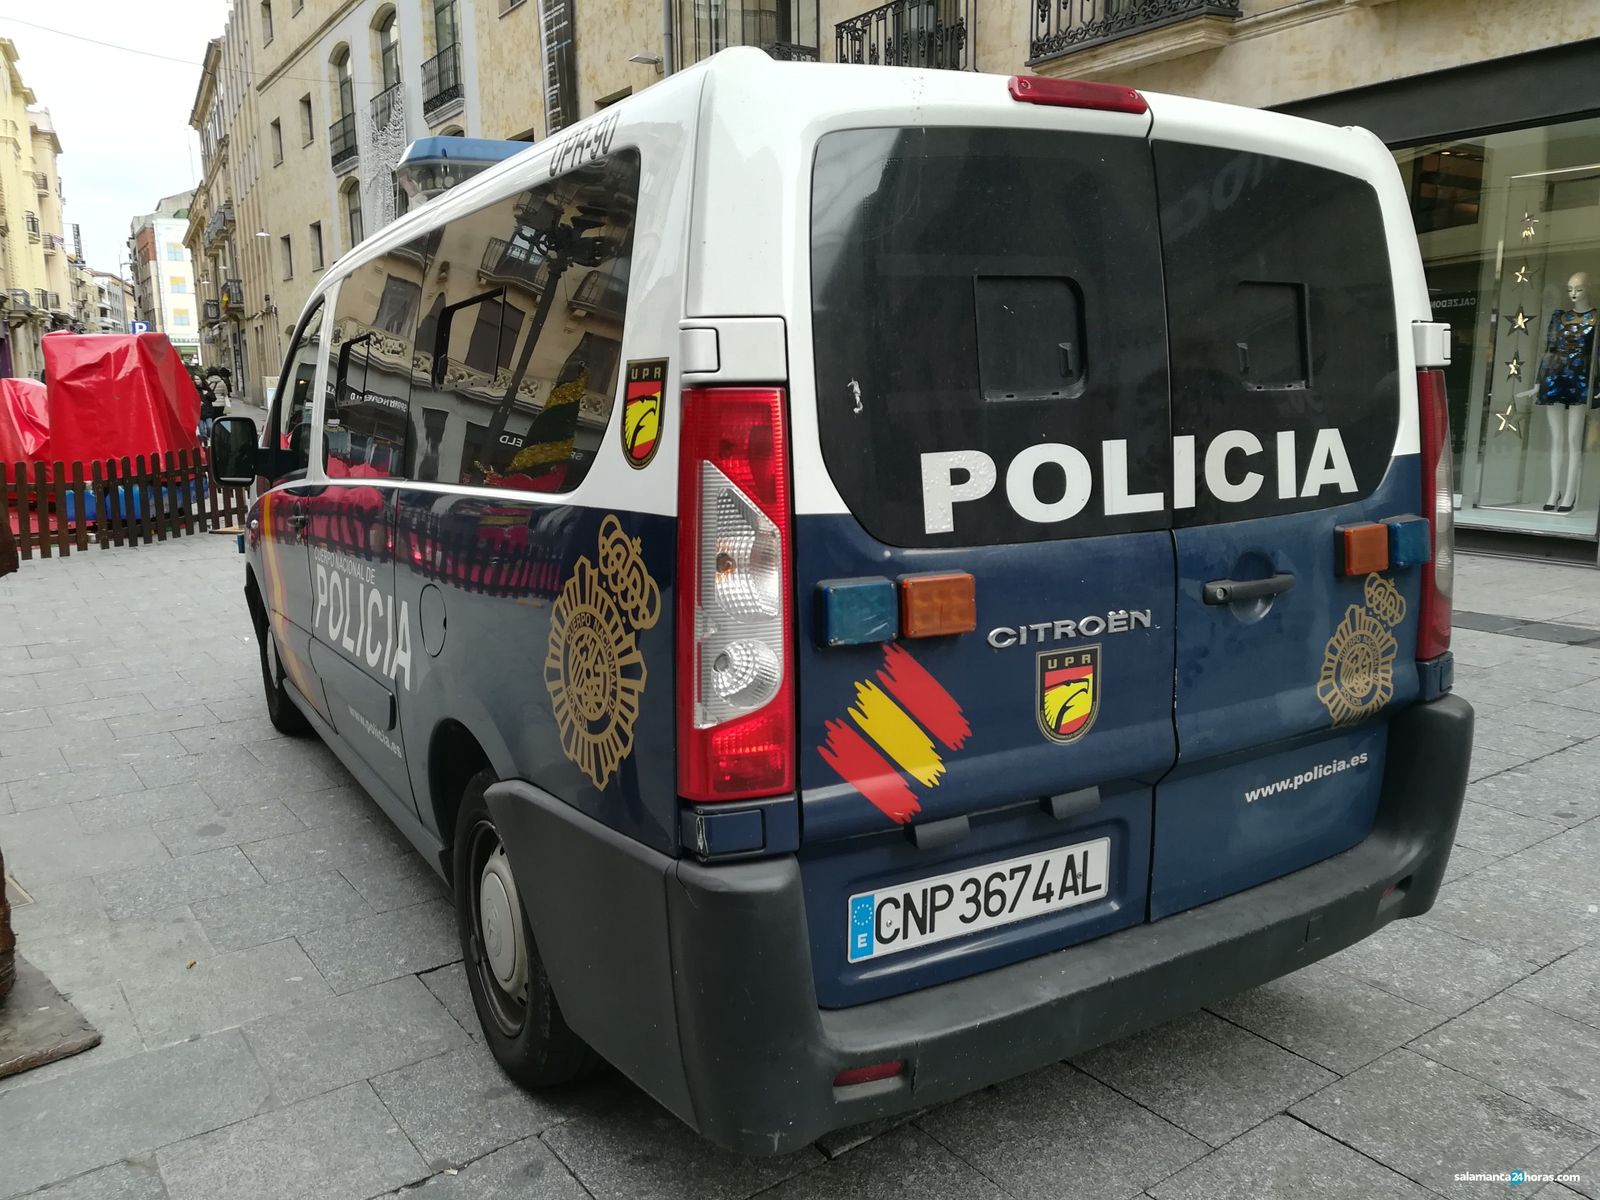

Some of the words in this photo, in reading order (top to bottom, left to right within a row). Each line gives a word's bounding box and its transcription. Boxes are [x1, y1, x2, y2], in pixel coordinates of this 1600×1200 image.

[134, 322, 148, 336] P
[631, 366, 662, 380] UPR
[920, 427, 1359, 535] POLICIA
[335, 553, 365, 581] NACIONAL
[366, 566, 376, 585] DE
[315, 563, 411, 692] POLICIA
[566, 612, 591, 645] CUERPO
[987, 609, 1152, 649] CITROËN
[1047, 653, 1092, 670] UPR
[1244, 752, 1369, 803] www.policia.es
[857, 932, 868, 948] E
